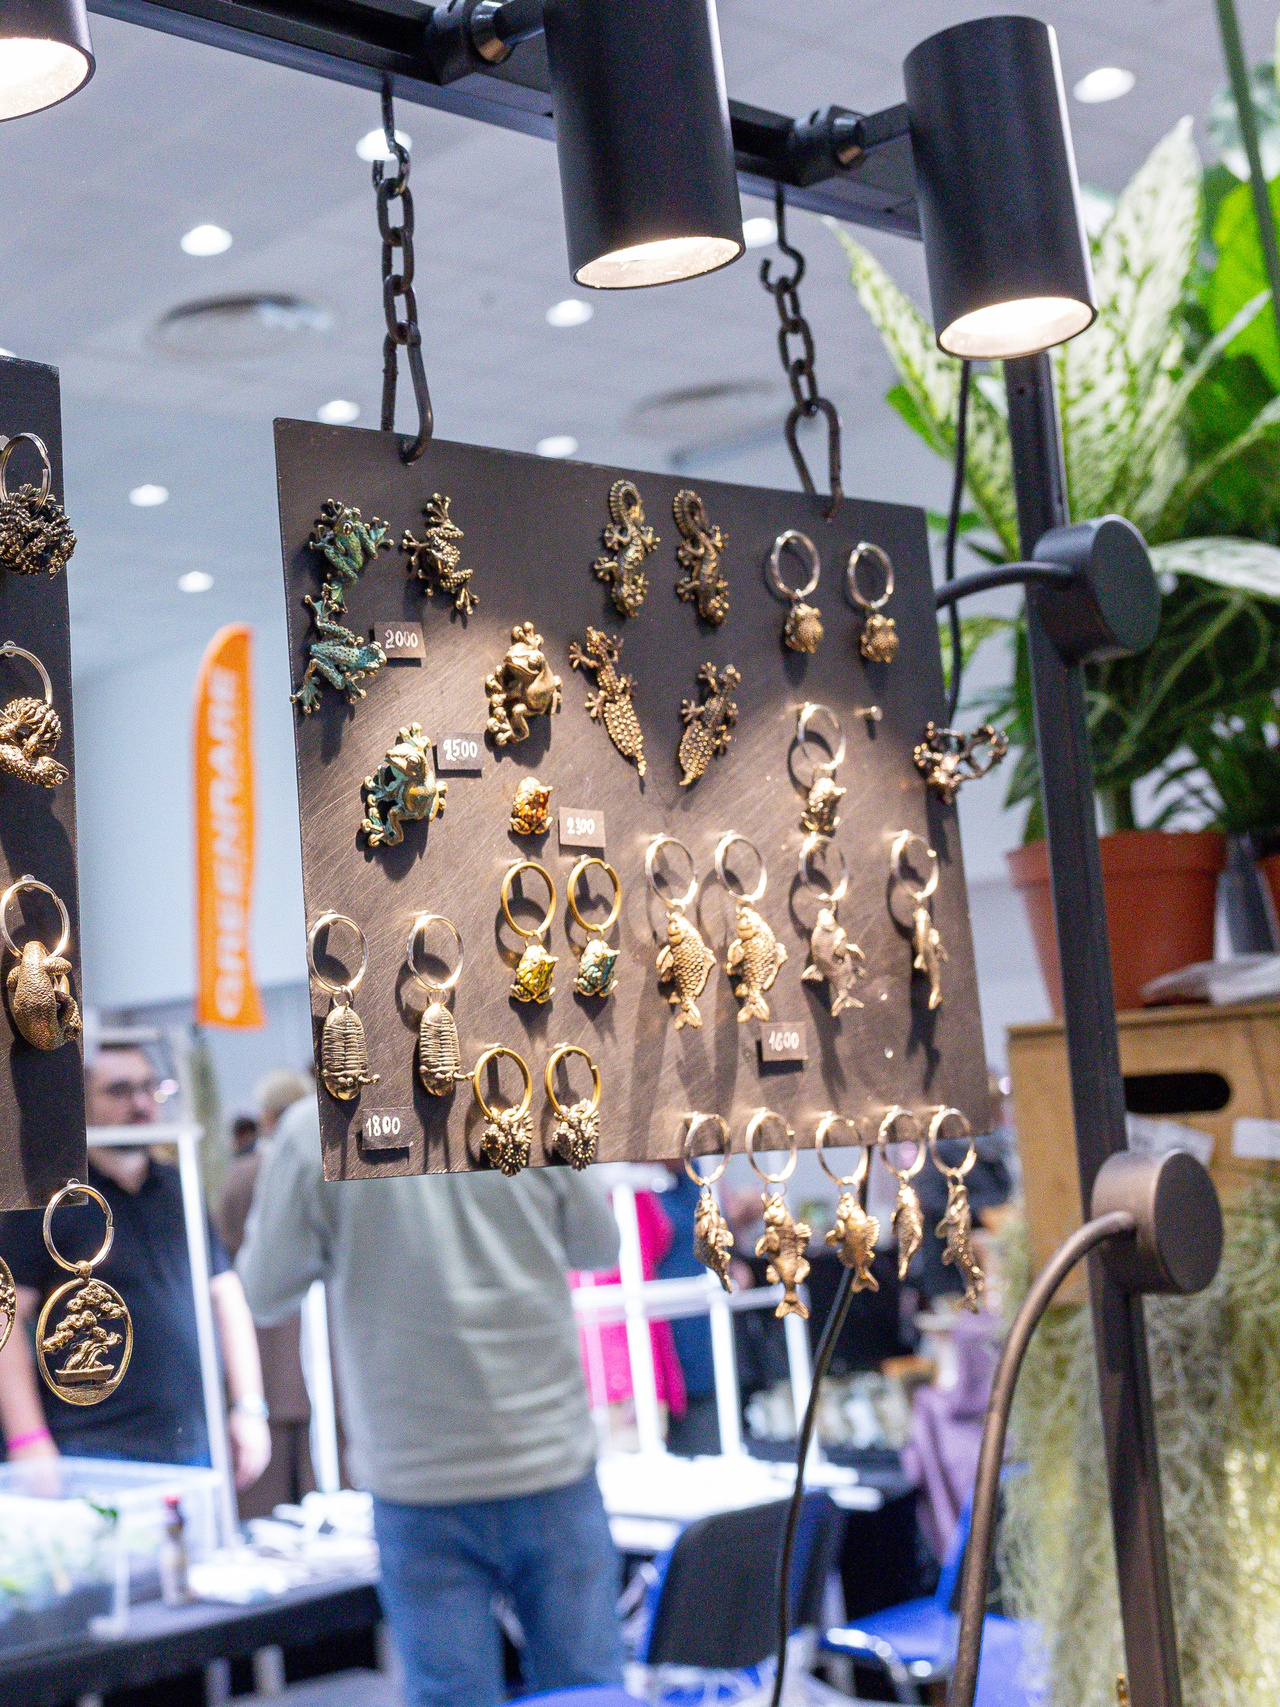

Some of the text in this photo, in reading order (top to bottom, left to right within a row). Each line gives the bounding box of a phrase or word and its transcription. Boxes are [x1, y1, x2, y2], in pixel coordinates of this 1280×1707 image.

[385, 629, 418, 649] 2000
[566, 816, 596, 836] 2300
[365, 1114, 401, 1137] 1800
